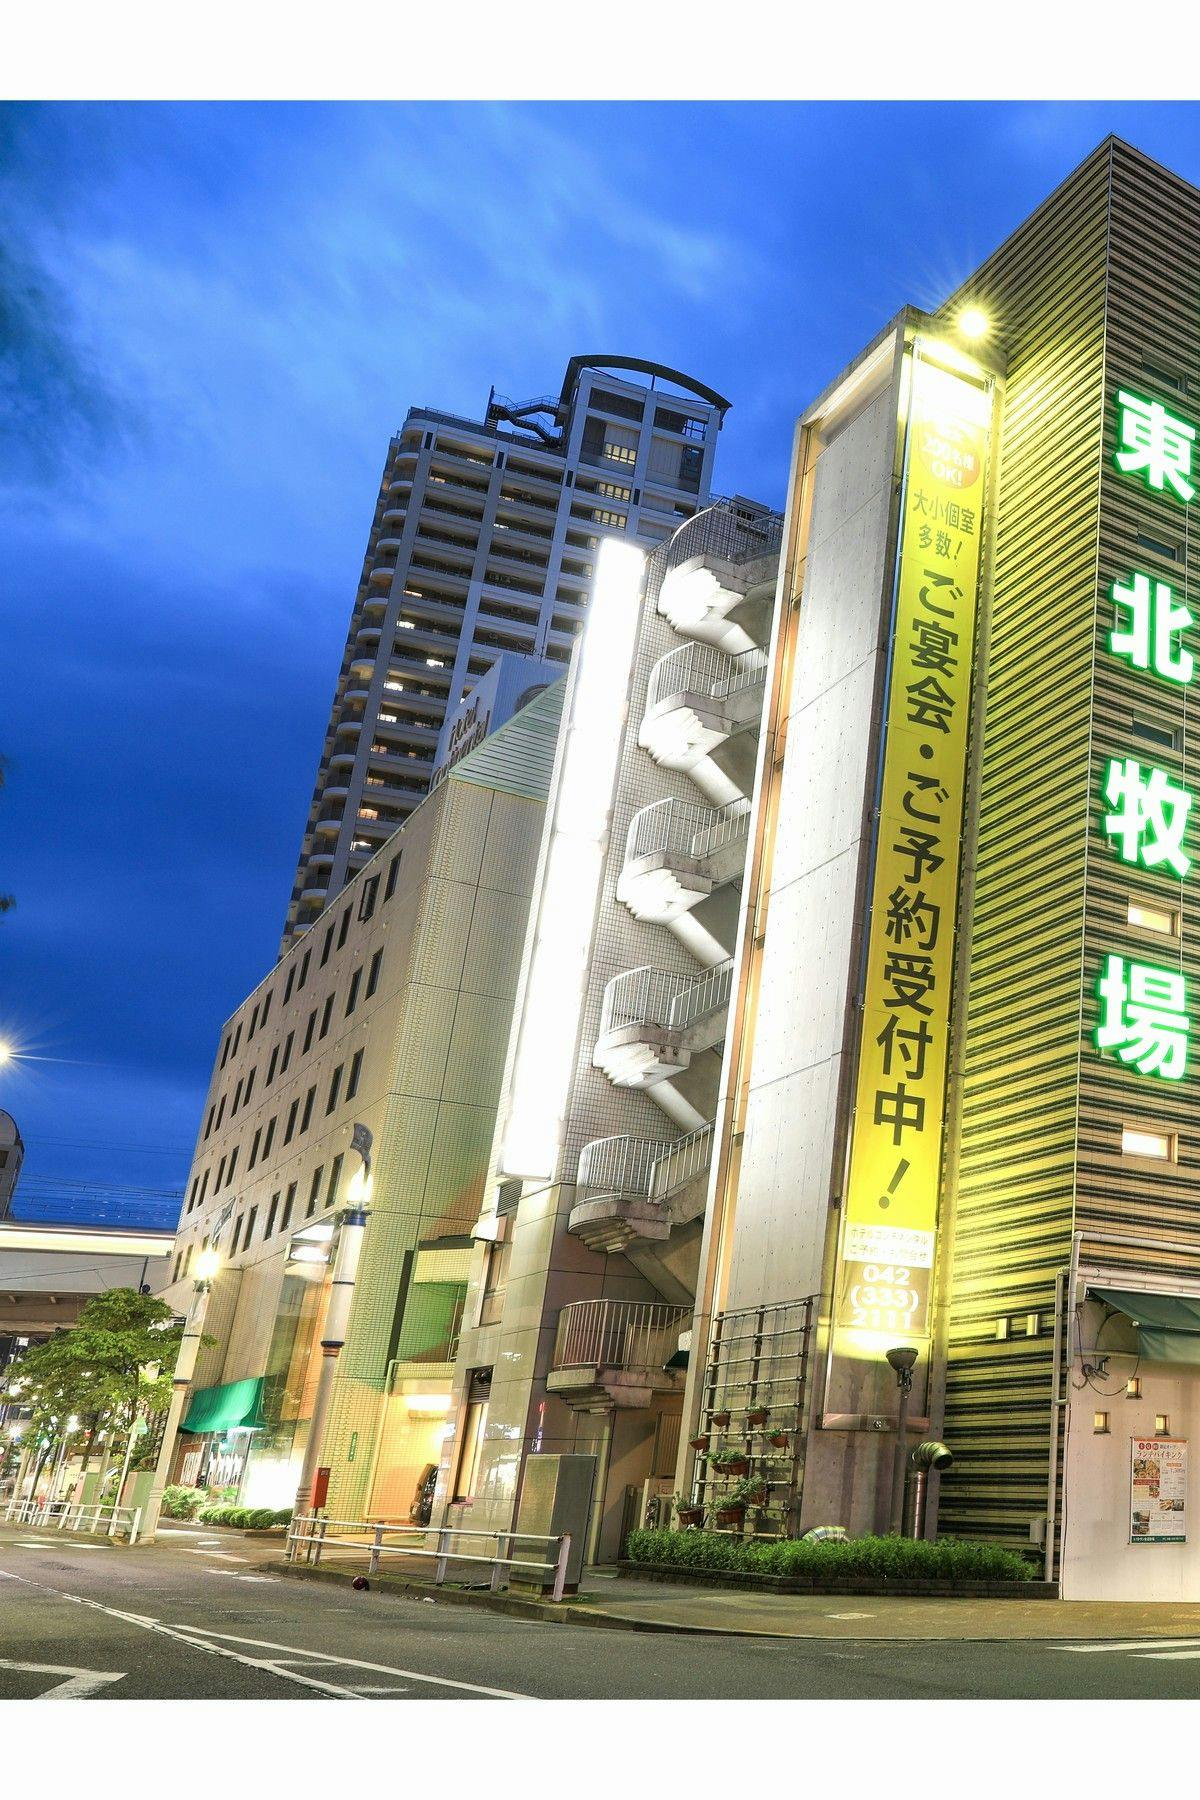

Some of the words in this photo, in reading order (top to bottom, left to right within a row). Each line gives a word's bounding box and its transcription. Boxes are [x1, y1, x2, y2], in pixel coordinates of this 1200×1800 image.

[912, 488, 976, 536] 大小個室
[1097, 389, 1197, 1083] 東北牧場
[862, 1263, 911, 1286] 042
